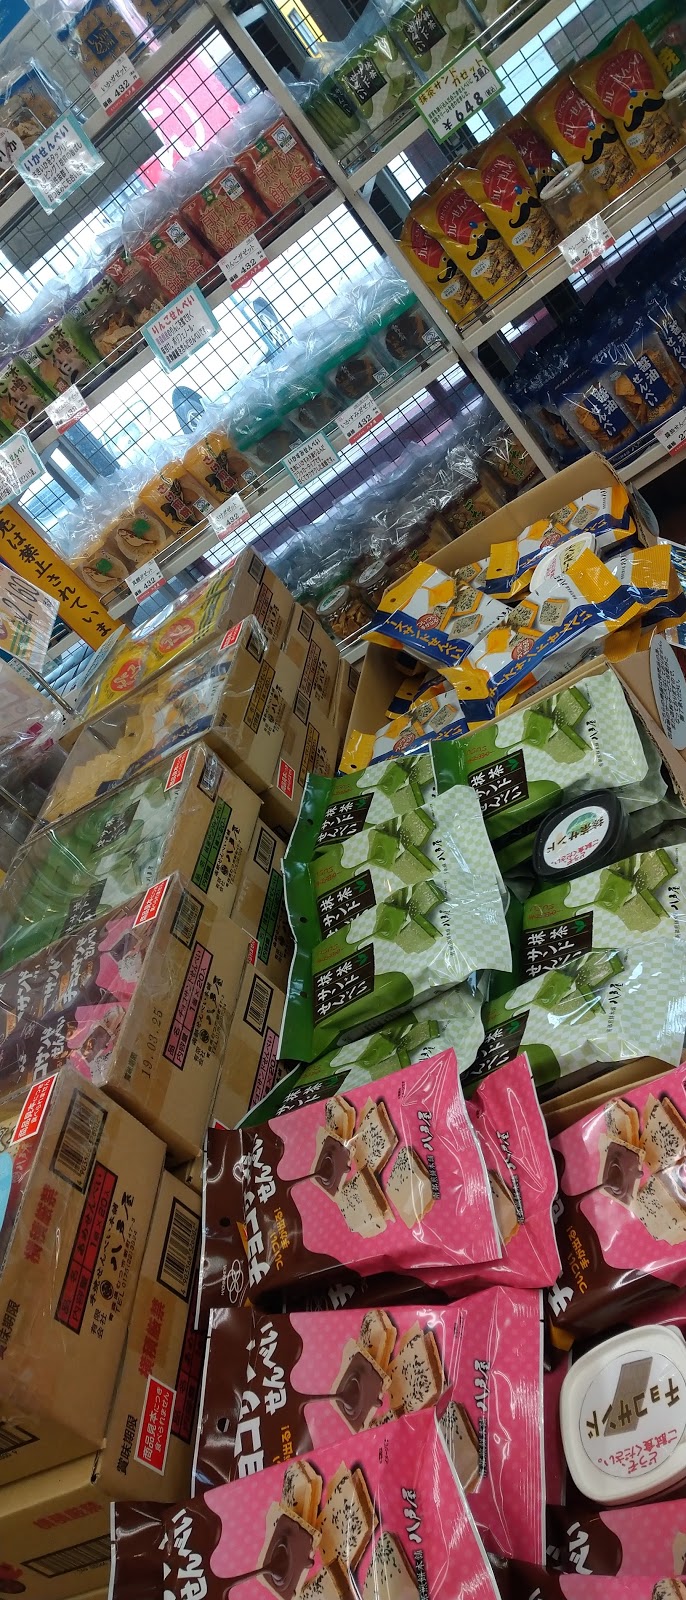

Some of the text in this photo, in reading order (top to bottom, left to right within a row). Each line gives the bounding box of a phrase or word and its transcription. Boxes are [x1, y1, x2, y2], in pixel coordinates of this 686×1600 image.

[114, 79, 130, 97] 432
[418, 67, 457, 106] 抹茶サンド
[452, 58, 483, 87] ガゼット
[23, 125, 69, 172] いかせんべい
[240, 258, 257, 274] 432
[151, 294, 195, 334] りんごせんべい
[633, 373, 658, 407] せんべい
[357, 414, 373, 429] 432
[471, 764, 505, 788] 抹茶
[322, 814, 354, 830] サンド
[325, 802, 353, 818] 抹茶
[318, 824, 357, 842] せんべい
[320, 887, 353, 912] 抹茶
[323, 900, 360, 927] サンド
[527, 940, 575, 962] サンド
[528, 925, 569, 946] 抹茶
[317, 962, 353, 988] 抹茶
[317, 974, 360, 1001] サンド
[206, 975, 223, 1025] 八戸屋
[317, 981, 367, 1016] せんべい
[142, 1007, 163, 1079] 19.03.25
[418, 1111, 435, 1151] 八戸屋
[253, 1134, 278, 1203] せんべい
[78, 1174, 102, 1255] あめせんべい
[111, 1192, 134, 1271] 八戸屋
[565, 1224, 591, 1270] 手が出る！
[567, 1252, 589, 1294] ついつい
[258, 1321, 287, 1415] せんべい
[473, 1358, 490, 1411] 八戸屋
[143, 1386, 163, 1460] 商品見本につき
[154, 1392, 170, 1453] 食べられません
[586, 1378, 680, 1439] チョコサンド
[116, 1415, 138, 1476] 賞味期限
[598, 1429, 678, 1467] ご試食ください。
[621, 1451, 659, 1474] どうぞ、
[402, 1488, 422, 1544] 八戸屋
